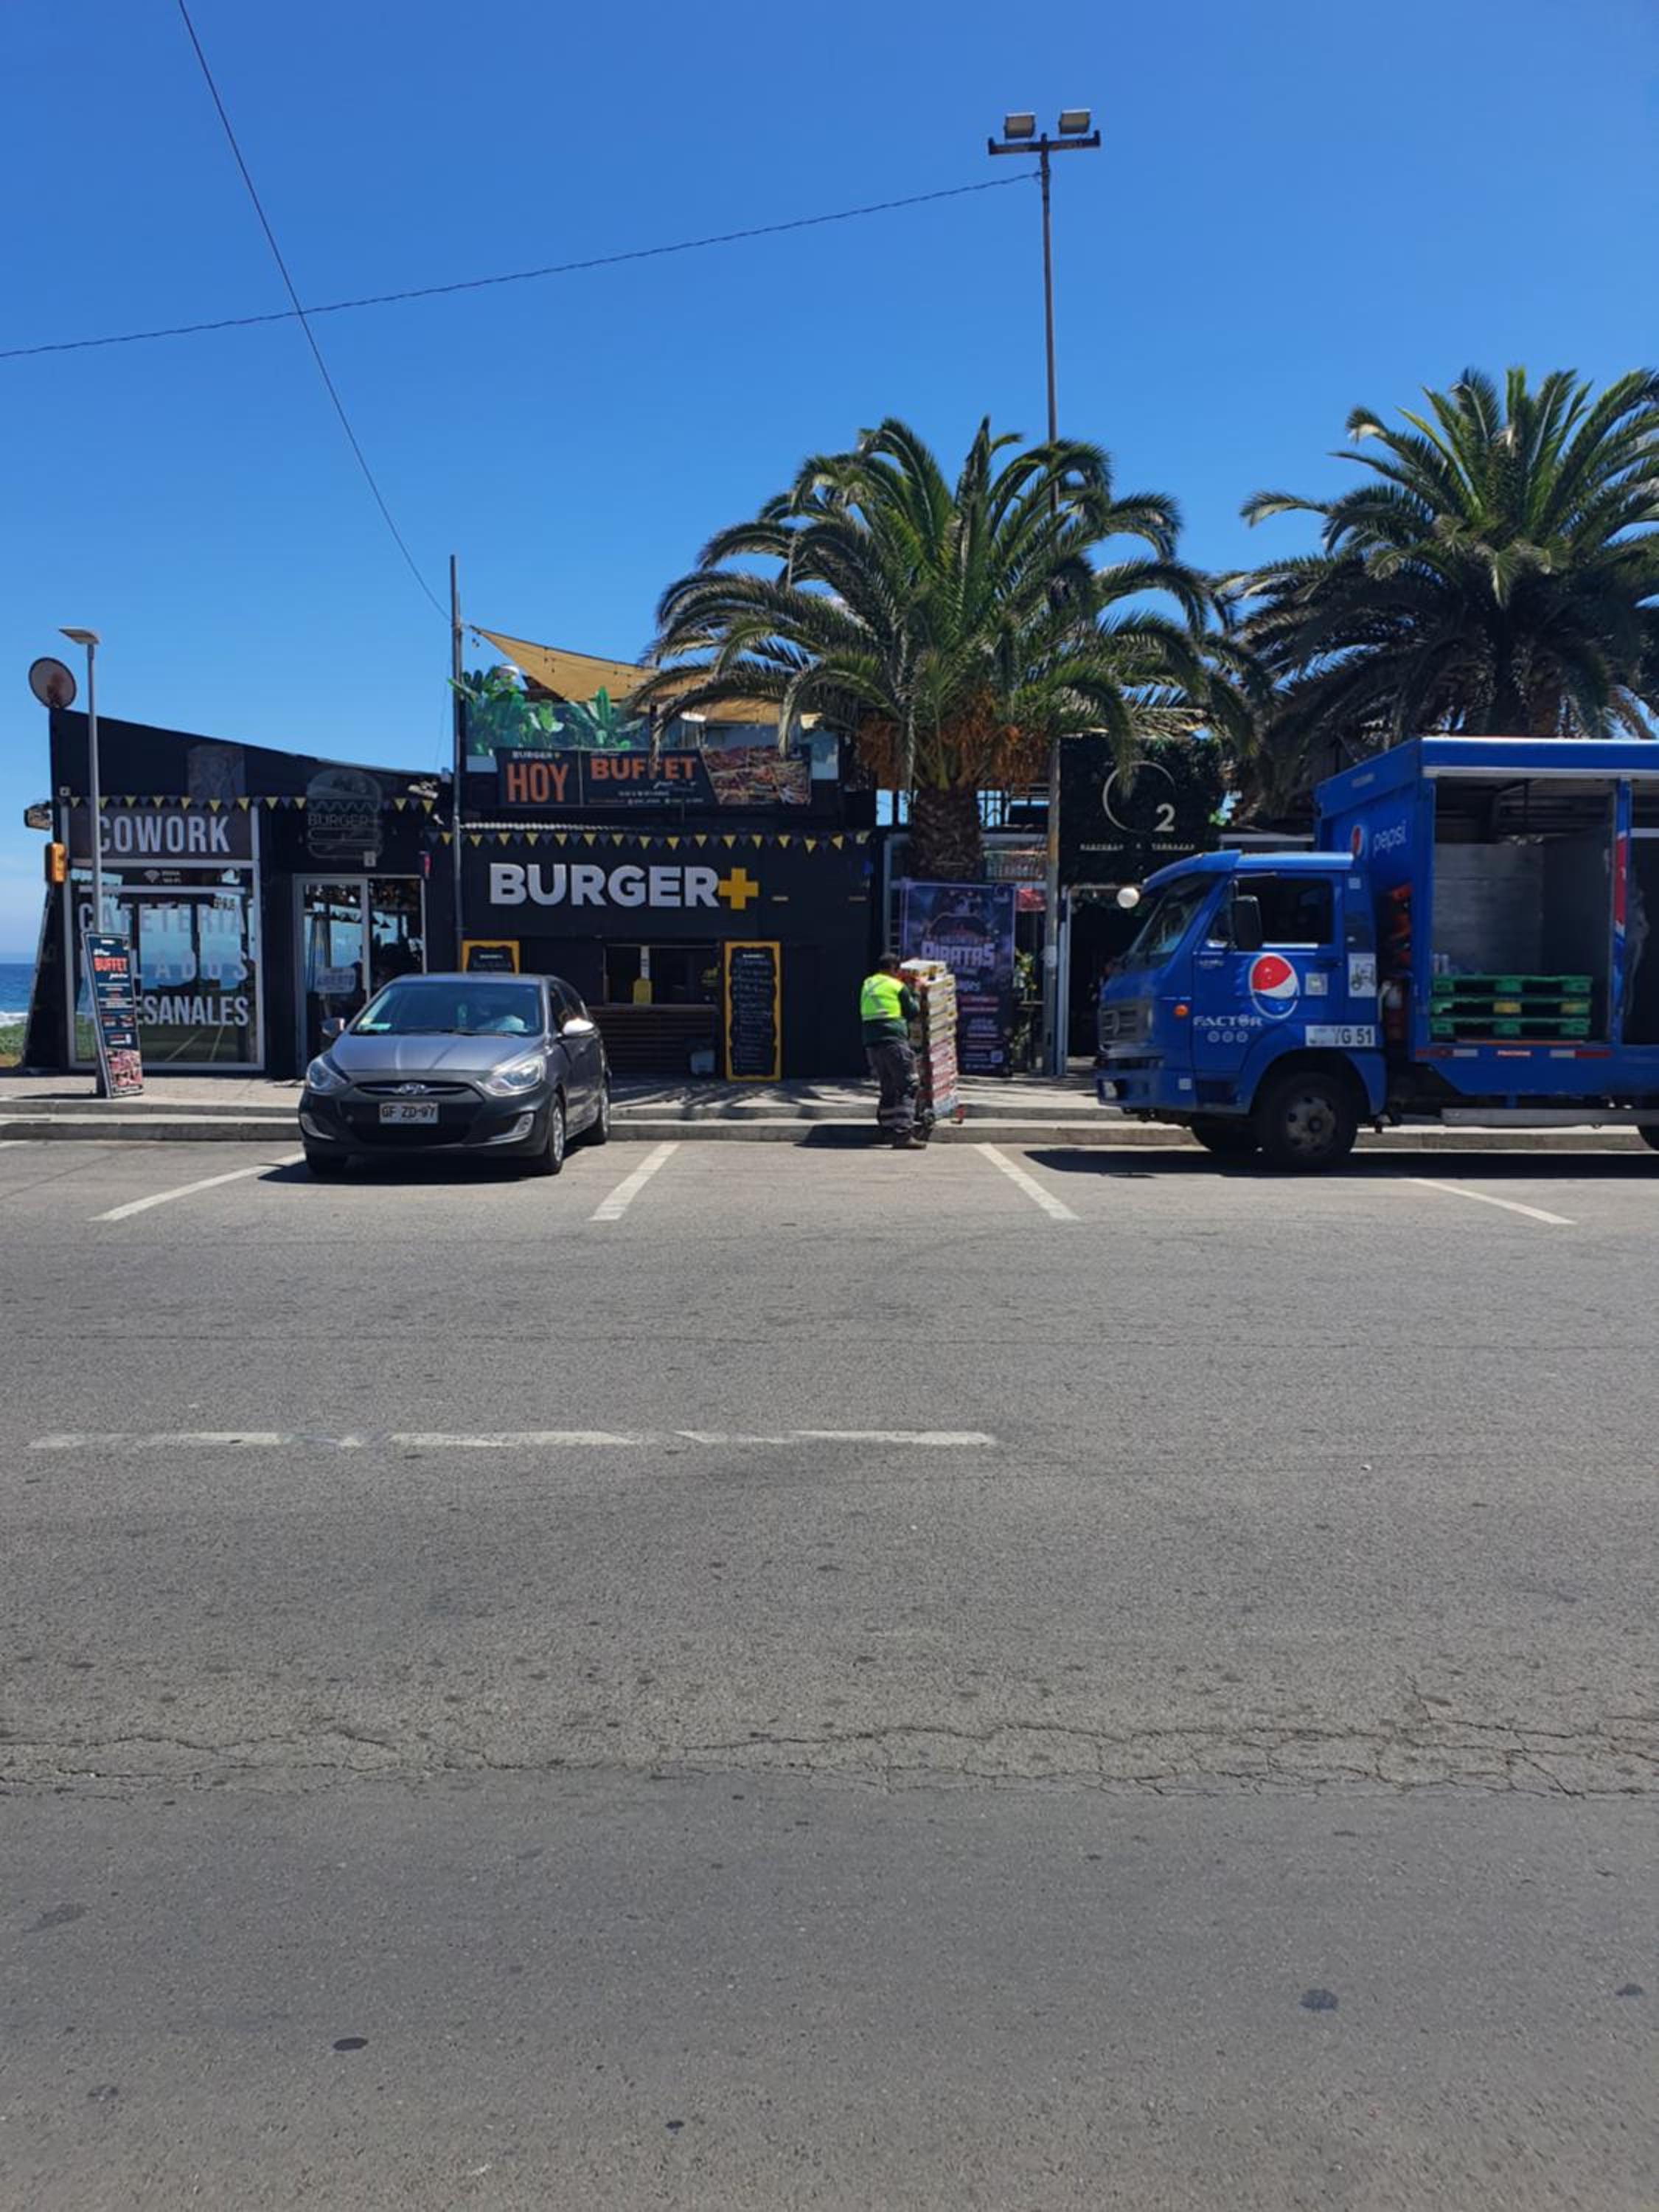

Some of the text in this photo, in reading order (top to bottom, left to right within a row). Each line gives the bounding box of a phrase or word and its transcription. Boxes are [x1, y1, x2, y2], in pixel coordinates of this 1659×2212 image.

[507, 763, 568, 803] HOY
[99, 815, 231, 853] COWORK
[1372, 818, 1408, 858] pepsi
[80, 948, 248, 980] LADOS
[922, 941, 995, 969] PIRATAS
[135, 995, 249, 1026] ESANALES
[1356, 1027, 1372, 1045] 51
